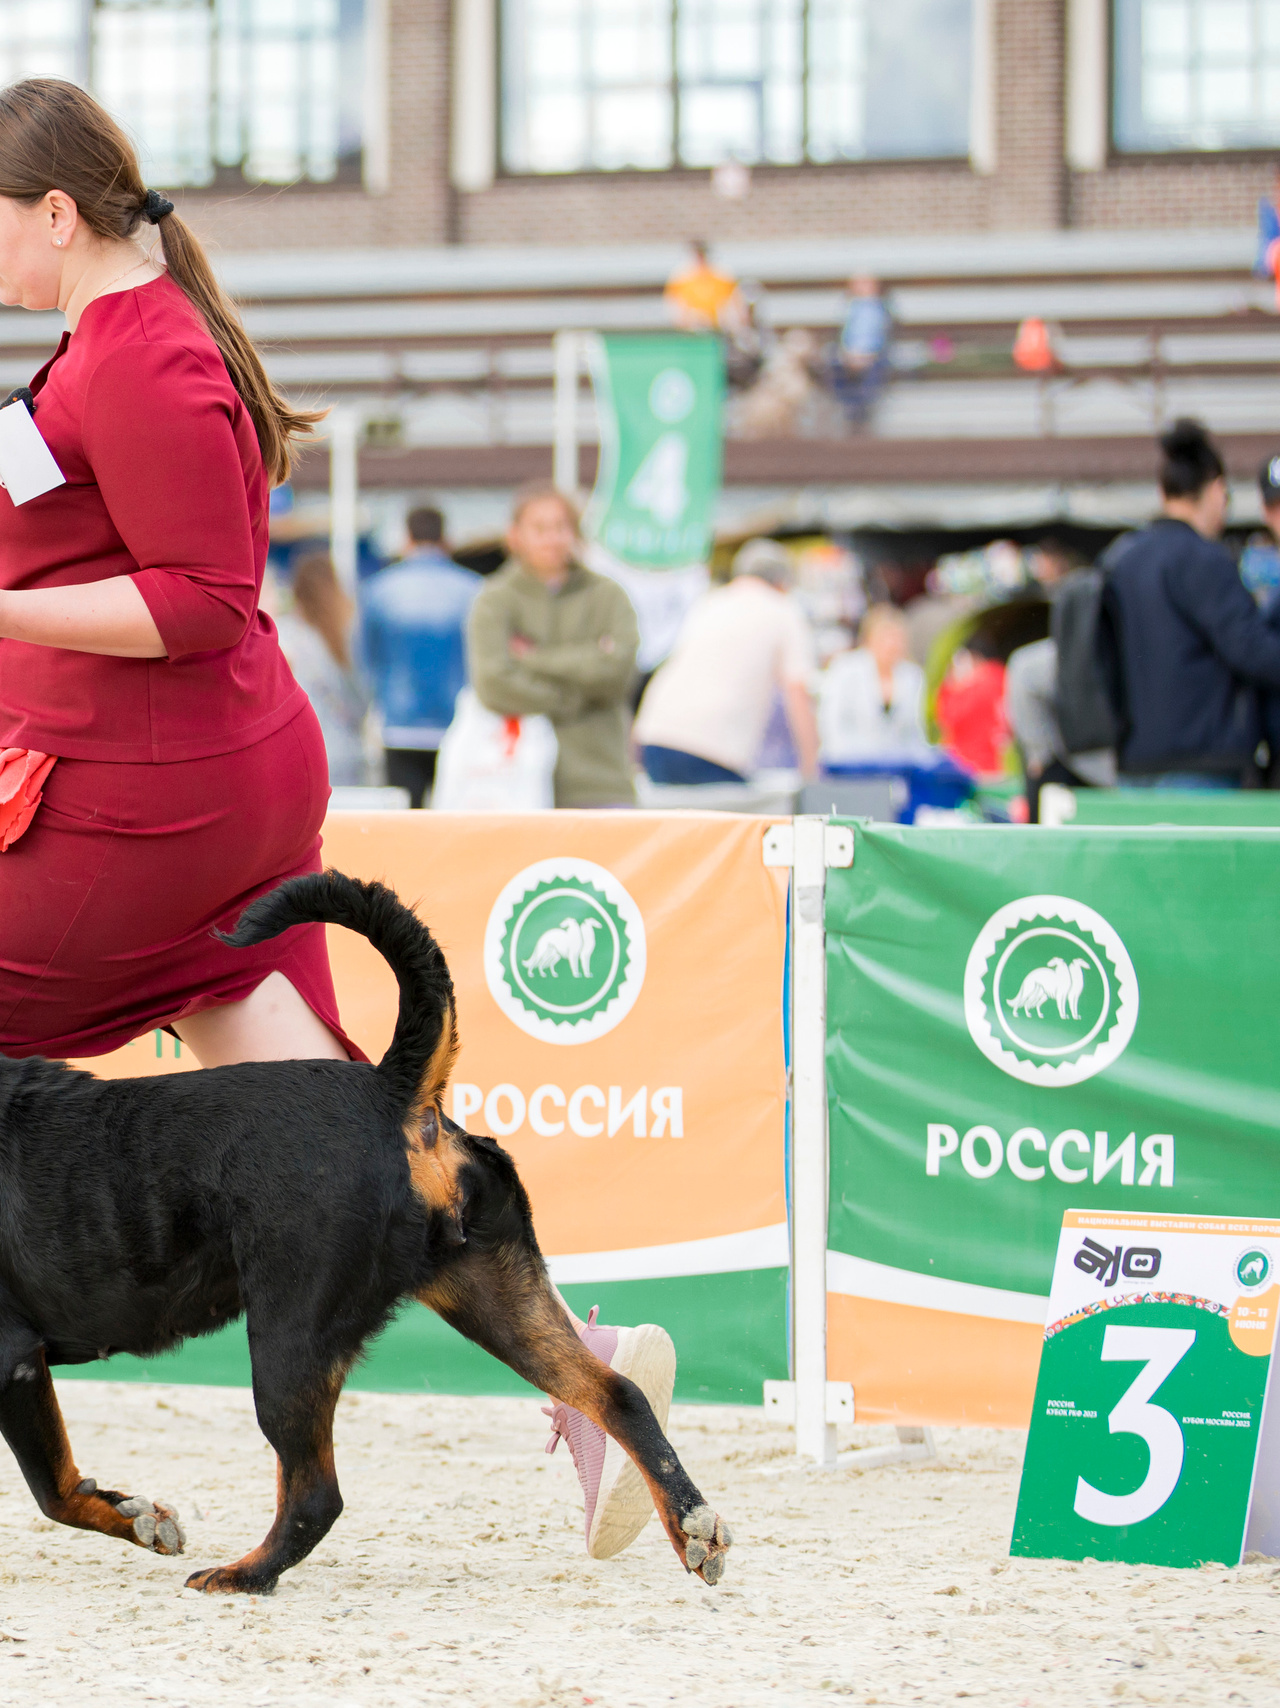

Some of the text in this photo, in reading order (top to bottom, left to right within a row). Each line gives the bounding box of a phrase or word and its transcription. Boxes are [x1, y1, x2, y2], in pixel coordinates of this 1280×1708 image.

[626, 434, 690, 528] 4
[452, 1082, 684, 1138] РОССИЯ
[925, 1123, 1175, 1187] РОССИЯ
[1077, 1216, 1149, 1228] НАЦИОНАЛЬНЫЕ
[1149, 1219, 1196, 1230] ВЫСТАВКИ
[1197, 1222, 1227, 1231] СОБАК
[1227, 1223, 1250, 1232] ВСЕХ
[1234, 1319, 1267, 1330] ИЮНЯ
[1237, 1306, 1250, 1317] 10
[1257, 1308, 1269, 1318] 11
[1072, 1324, 1197, 1527] 3
